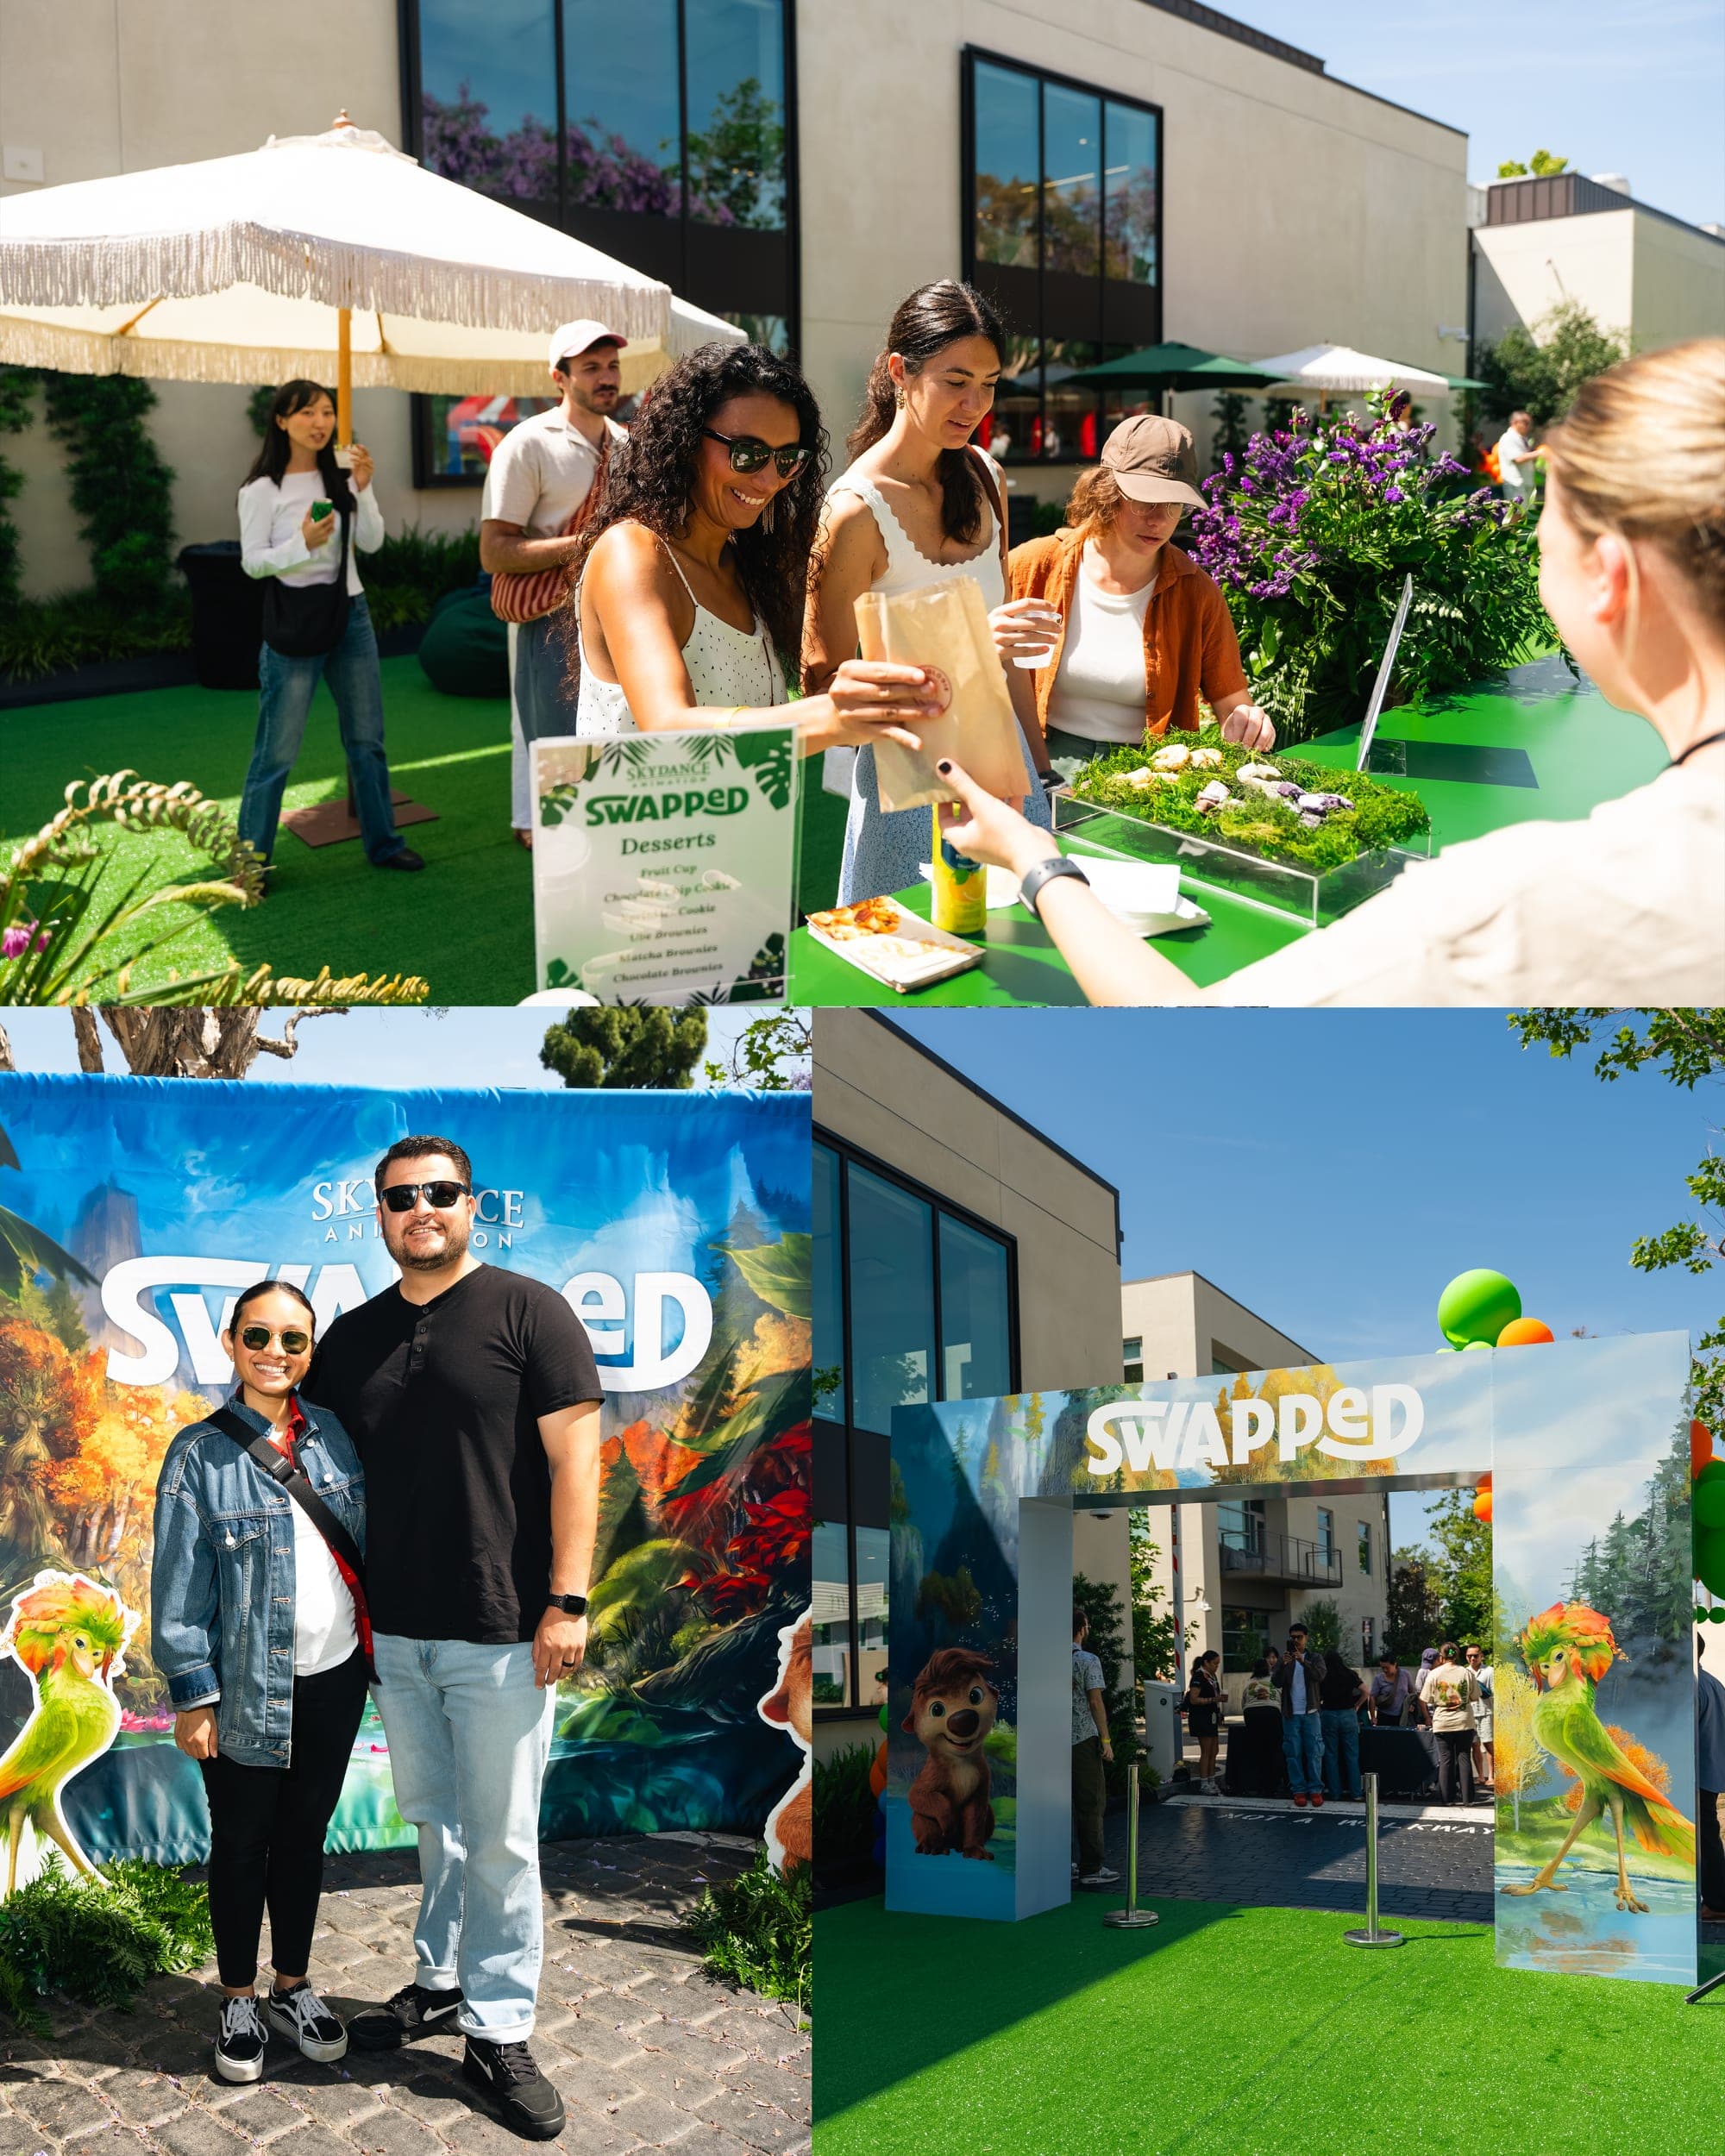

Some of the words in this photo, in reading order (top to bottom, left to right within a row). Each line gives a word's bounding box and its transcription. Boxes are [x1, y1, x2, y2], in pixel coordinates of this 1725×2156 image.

[626, 761, 711, 781] SKYDANCE
[621, 832, 717, 856] Desserts
[641, 866, 670, 877] Fruit
[674, 864, 697, 875] Cup
[679, 904, 716, 916] Cookie
[655, 925, 707, 940] Brownies
[619, 951, 662, 963] Matcha
[667, 944, 718, 958] Brownies
[613, 968, 668, 983] Chocolate
[672, 962, 724, 977] Brownies
[311, 1179, 525, 1229] SKCE
[324, 1222, 513, 1249] ANION
[1338, 1819, 1495, 1835] WLKWAY
